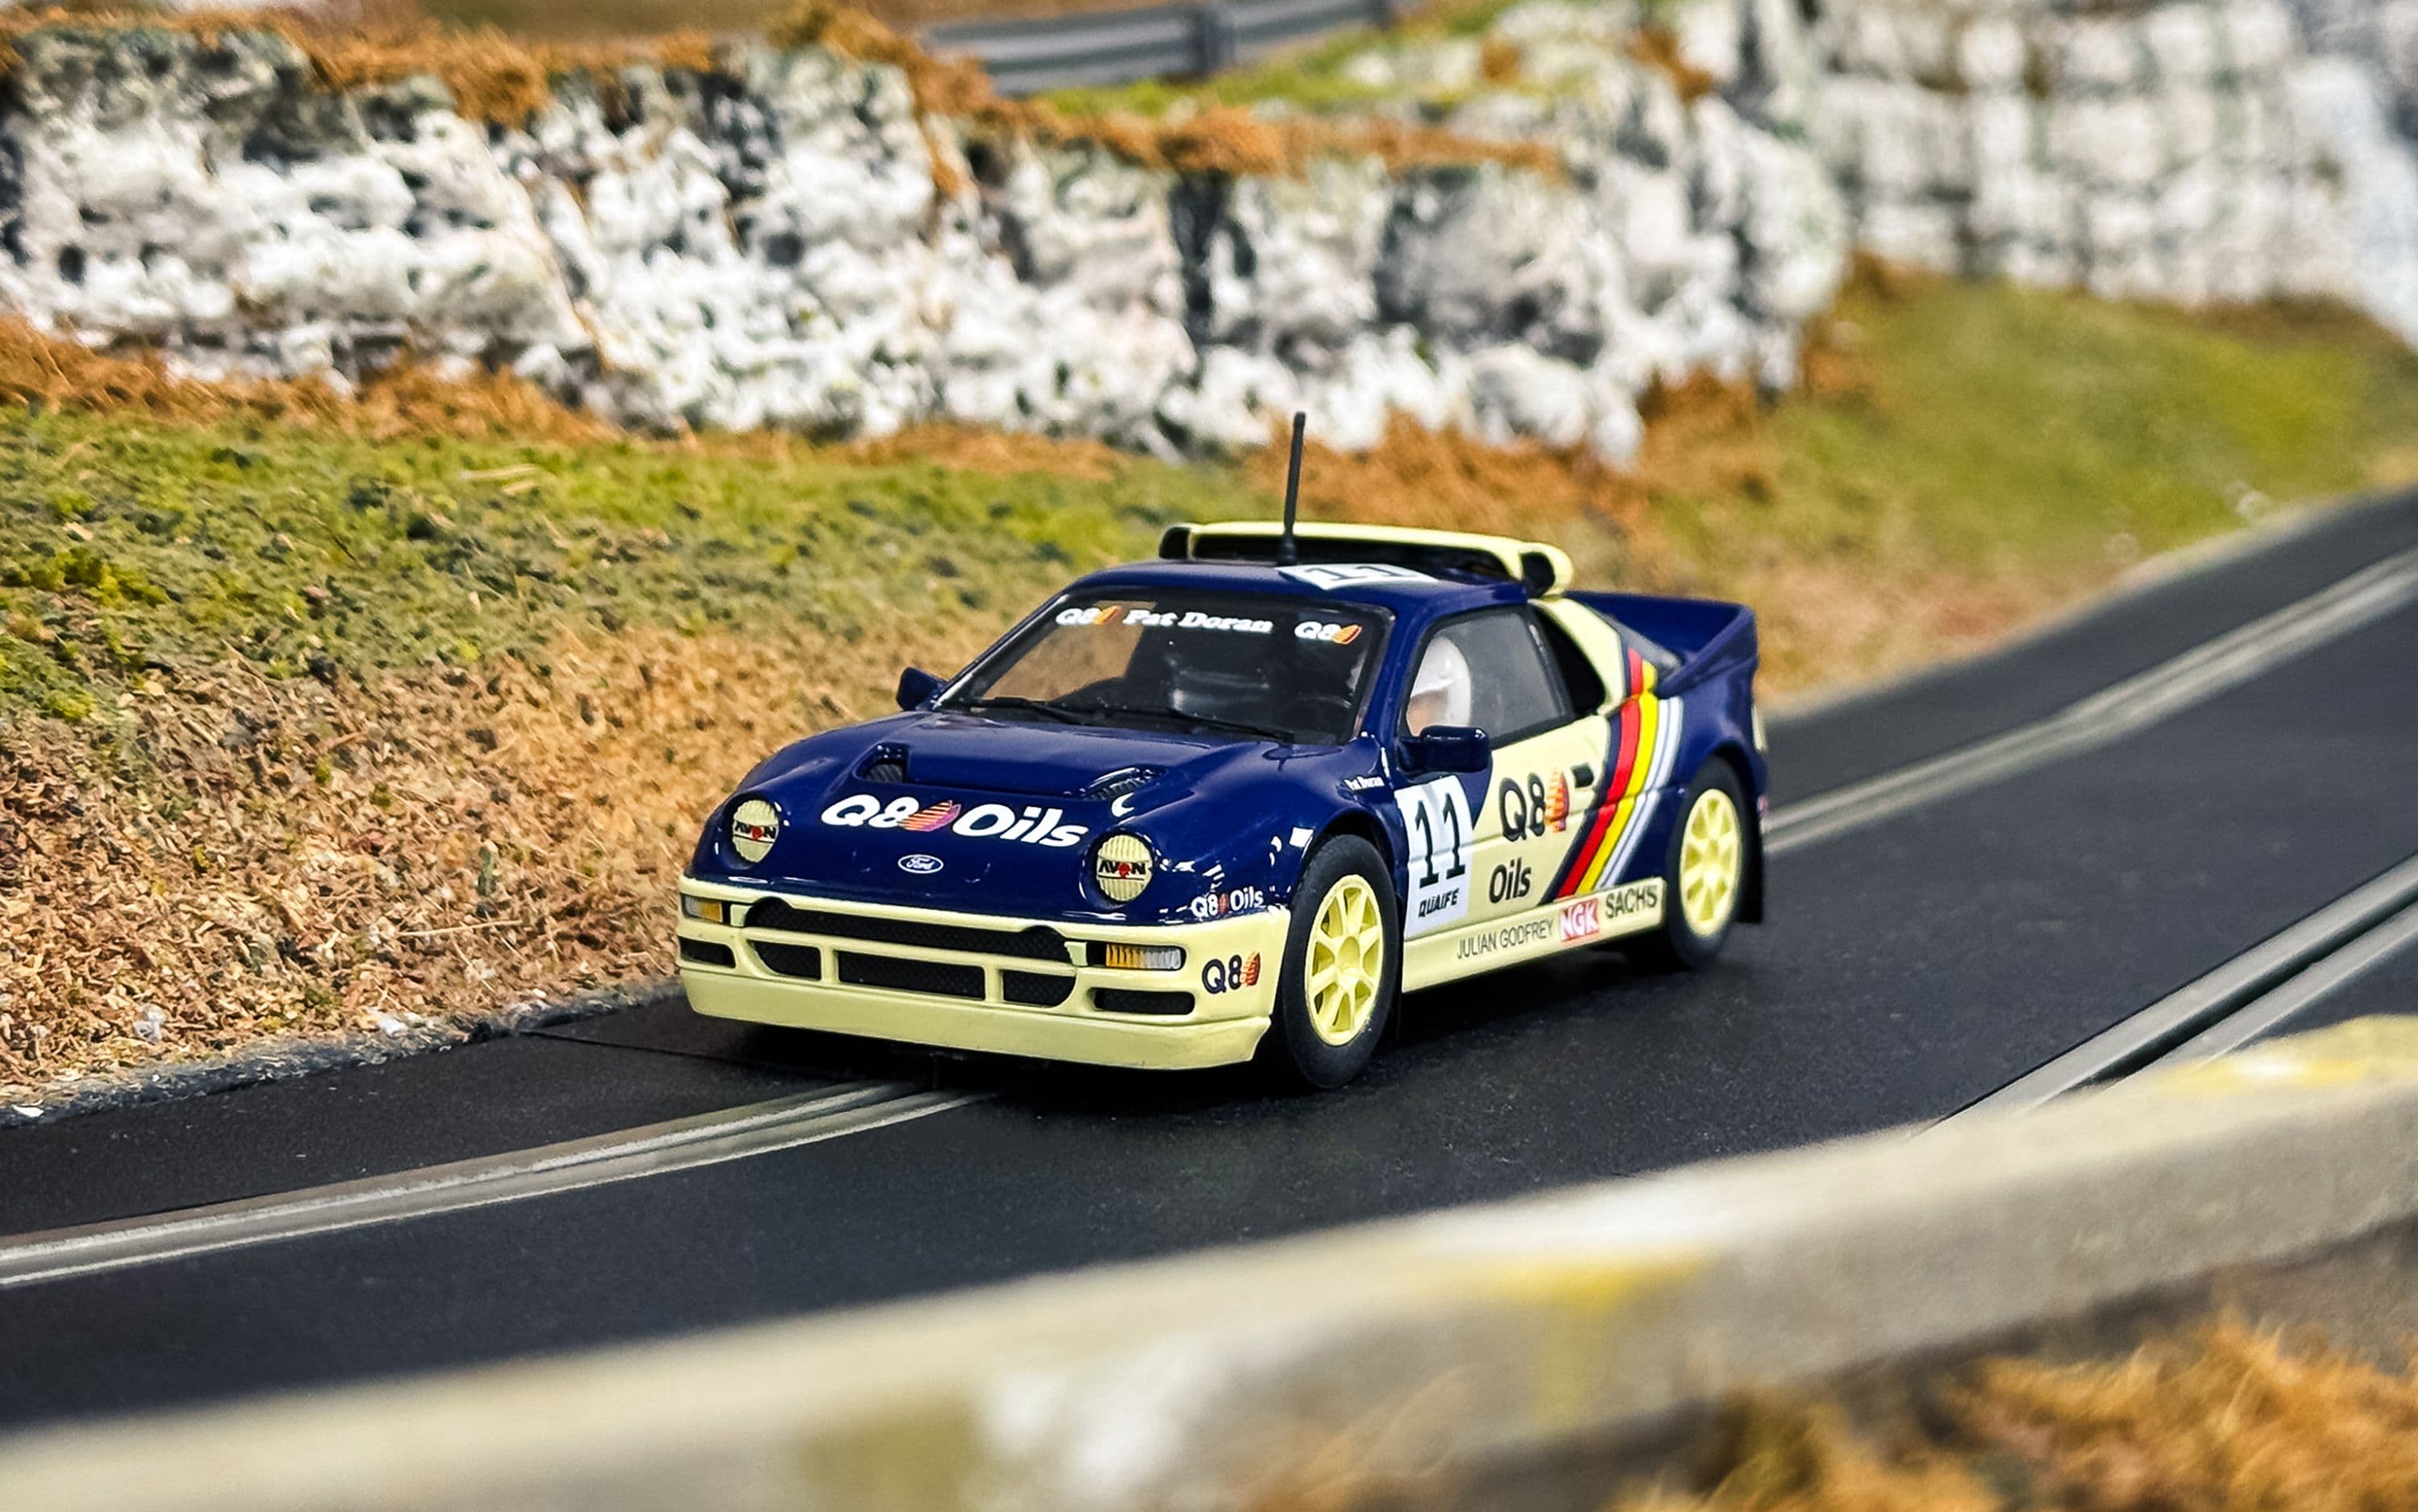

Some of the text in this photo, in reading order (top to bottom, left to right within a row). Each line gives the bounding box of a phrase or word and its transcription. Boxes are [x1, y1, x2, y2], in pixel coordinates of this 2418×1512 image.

[1055, 608, 1273, 633] Q8 Pat Doran
[1294, 621, 1336, 642] Q8
[821, 794, 1089, 847] Q8 Oils
[1499, 772, 1546, 842] Q8
[1415, 792, 1466, 888] 11
[1099, 859, 1146, 879] AVON
[1489, 857, 1531, 904] Oils
[1191, 886, 1265, 917] Q8 Oils
[1419, 887, 1460, 918] QUAIFE
[1456, 886, 1658, 959] JULIAN GODFREY NGK SACHS
[1202, 954, 1243, 995] Q8
